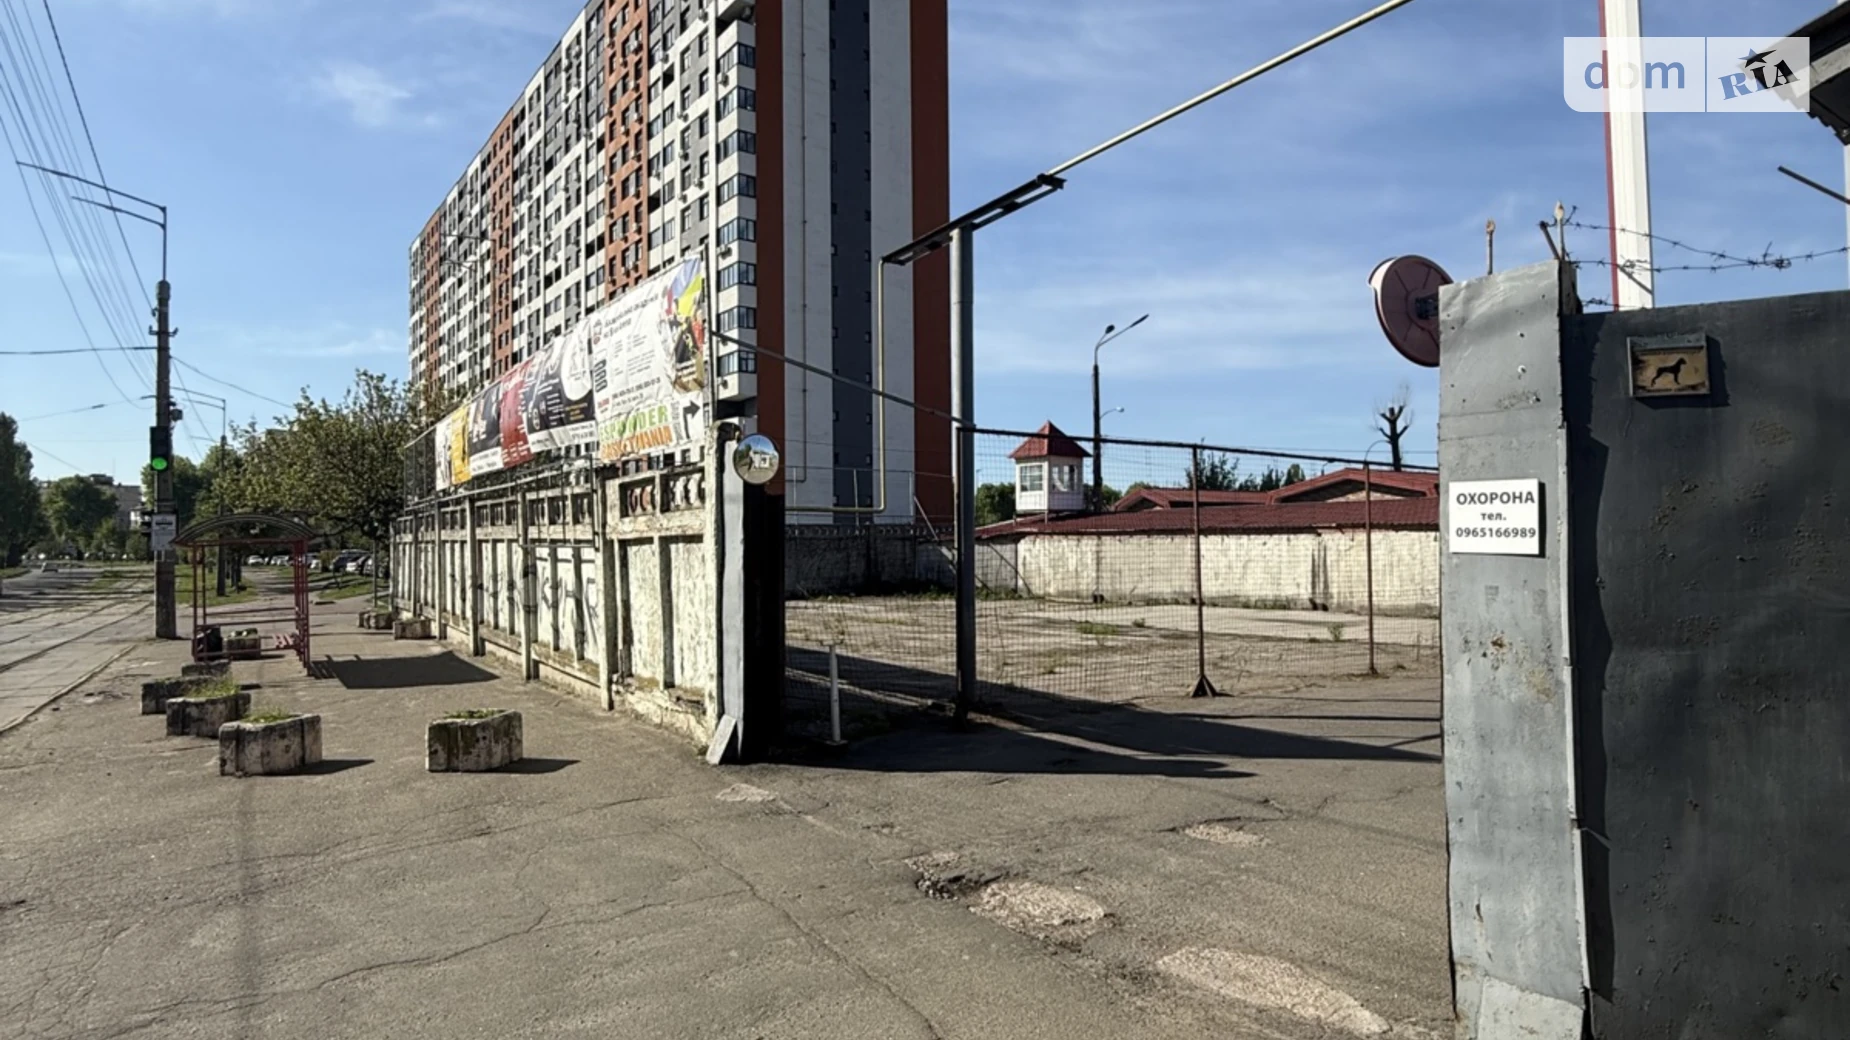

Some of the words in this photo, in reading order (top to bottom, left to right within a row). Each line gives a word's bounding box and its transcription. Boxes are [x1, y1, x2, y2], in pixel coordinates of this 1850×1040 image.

[1456, 490, 1535, 506] ОХОРОНА
[1480, 512, 1507, 521] тел.
[1455, 526, 1537, 539] 0965166989
